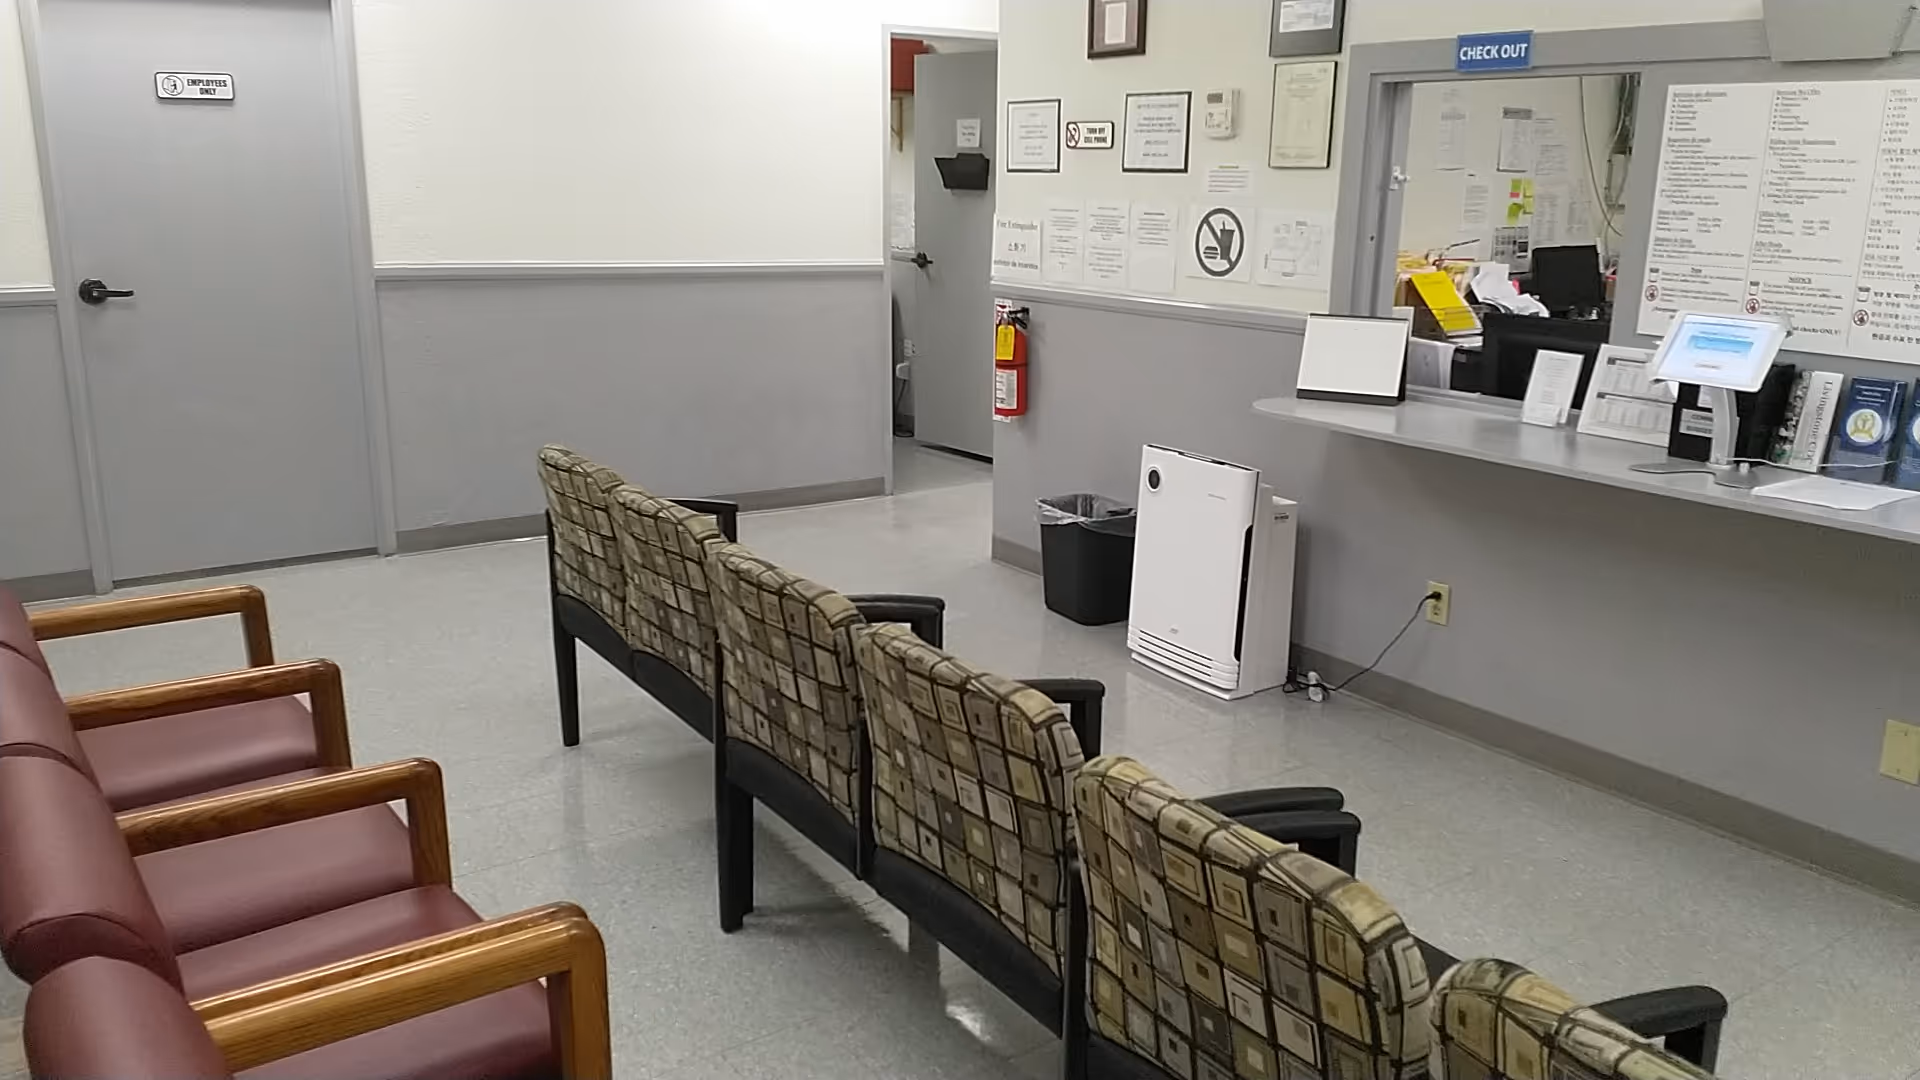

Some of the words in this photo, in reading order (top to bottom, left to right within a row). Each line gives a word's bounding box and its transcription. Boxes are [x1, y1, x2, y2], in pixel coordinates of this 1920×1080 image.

[1460, 46, 1499, 60] CHECK
[1501, 43, 1528, 58] OUT
[186, 79, 228, 87] EMPLOYEES
[199, 87, 217, 95] ONLY
[1084, 136, 1093, 144] CELL
